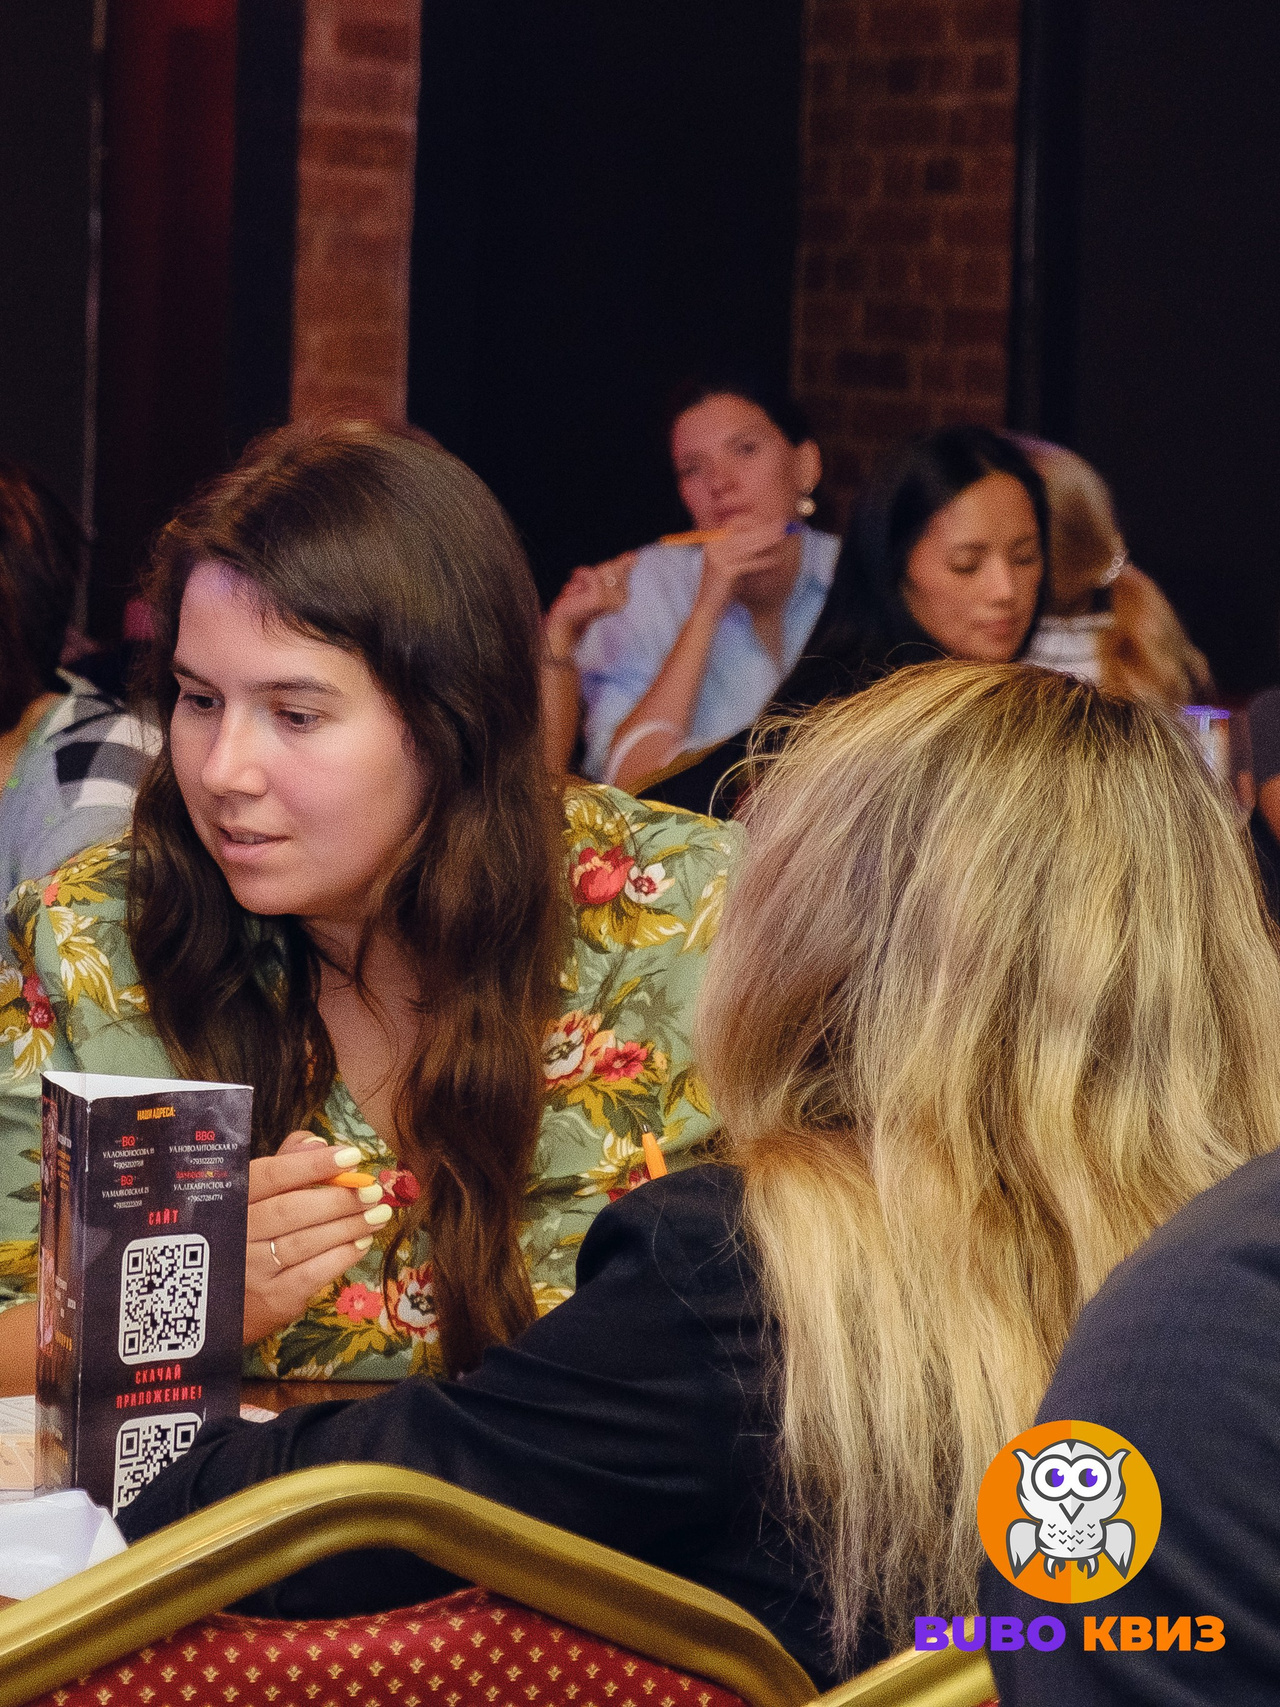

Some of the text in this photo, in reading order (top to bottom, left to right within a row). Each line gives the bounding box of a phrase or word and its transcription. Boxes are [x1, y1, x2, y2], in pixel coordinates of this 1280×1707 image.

[195, 1130, 215, 1141] BBQ
[148, 1209, 179, 1225] САЙТ
[135, 1364, 181, 1384] СКАЧАЙ
[116, 1385, 202, 1409] ПРИЛОЖЕНИЕ!
